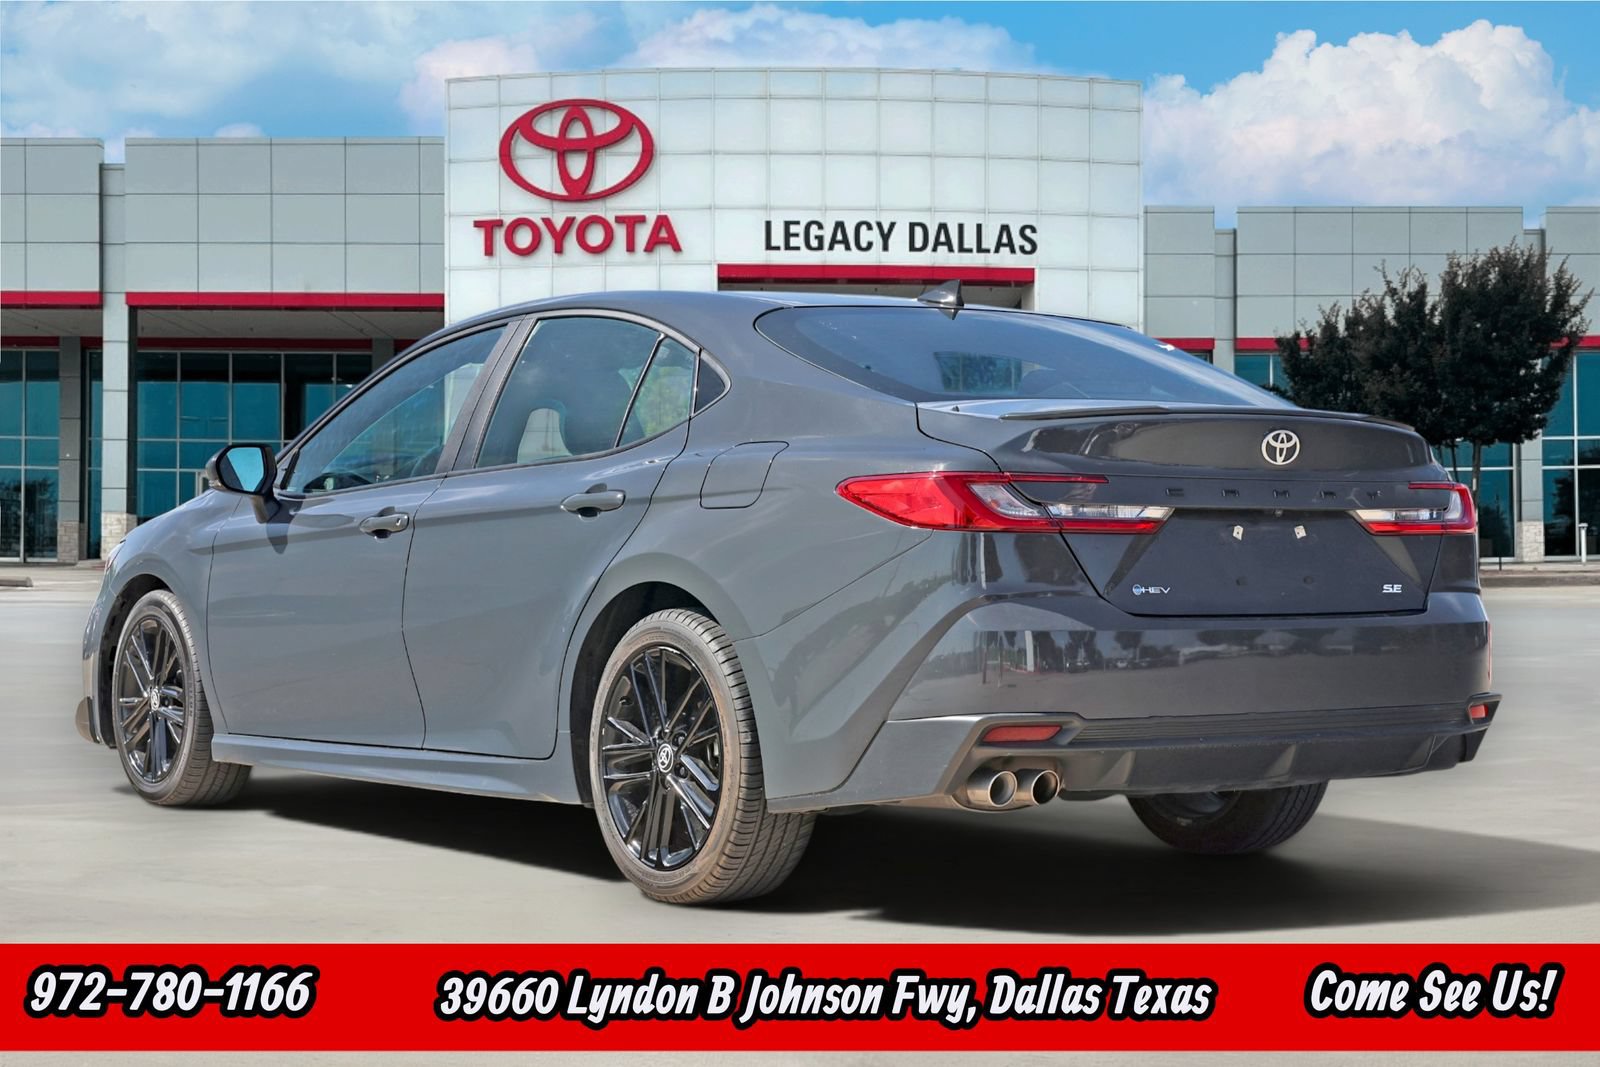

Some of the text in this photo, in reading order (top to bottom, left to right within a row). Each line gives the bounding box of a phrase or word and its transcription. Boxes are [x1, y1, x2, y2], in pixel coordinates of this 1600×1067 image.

[474, 214, 682, 257] TOYOTA
[765, 220, 1038, 255] LEGACY DALLAS
[1382, 584, 1403, 593] SE
